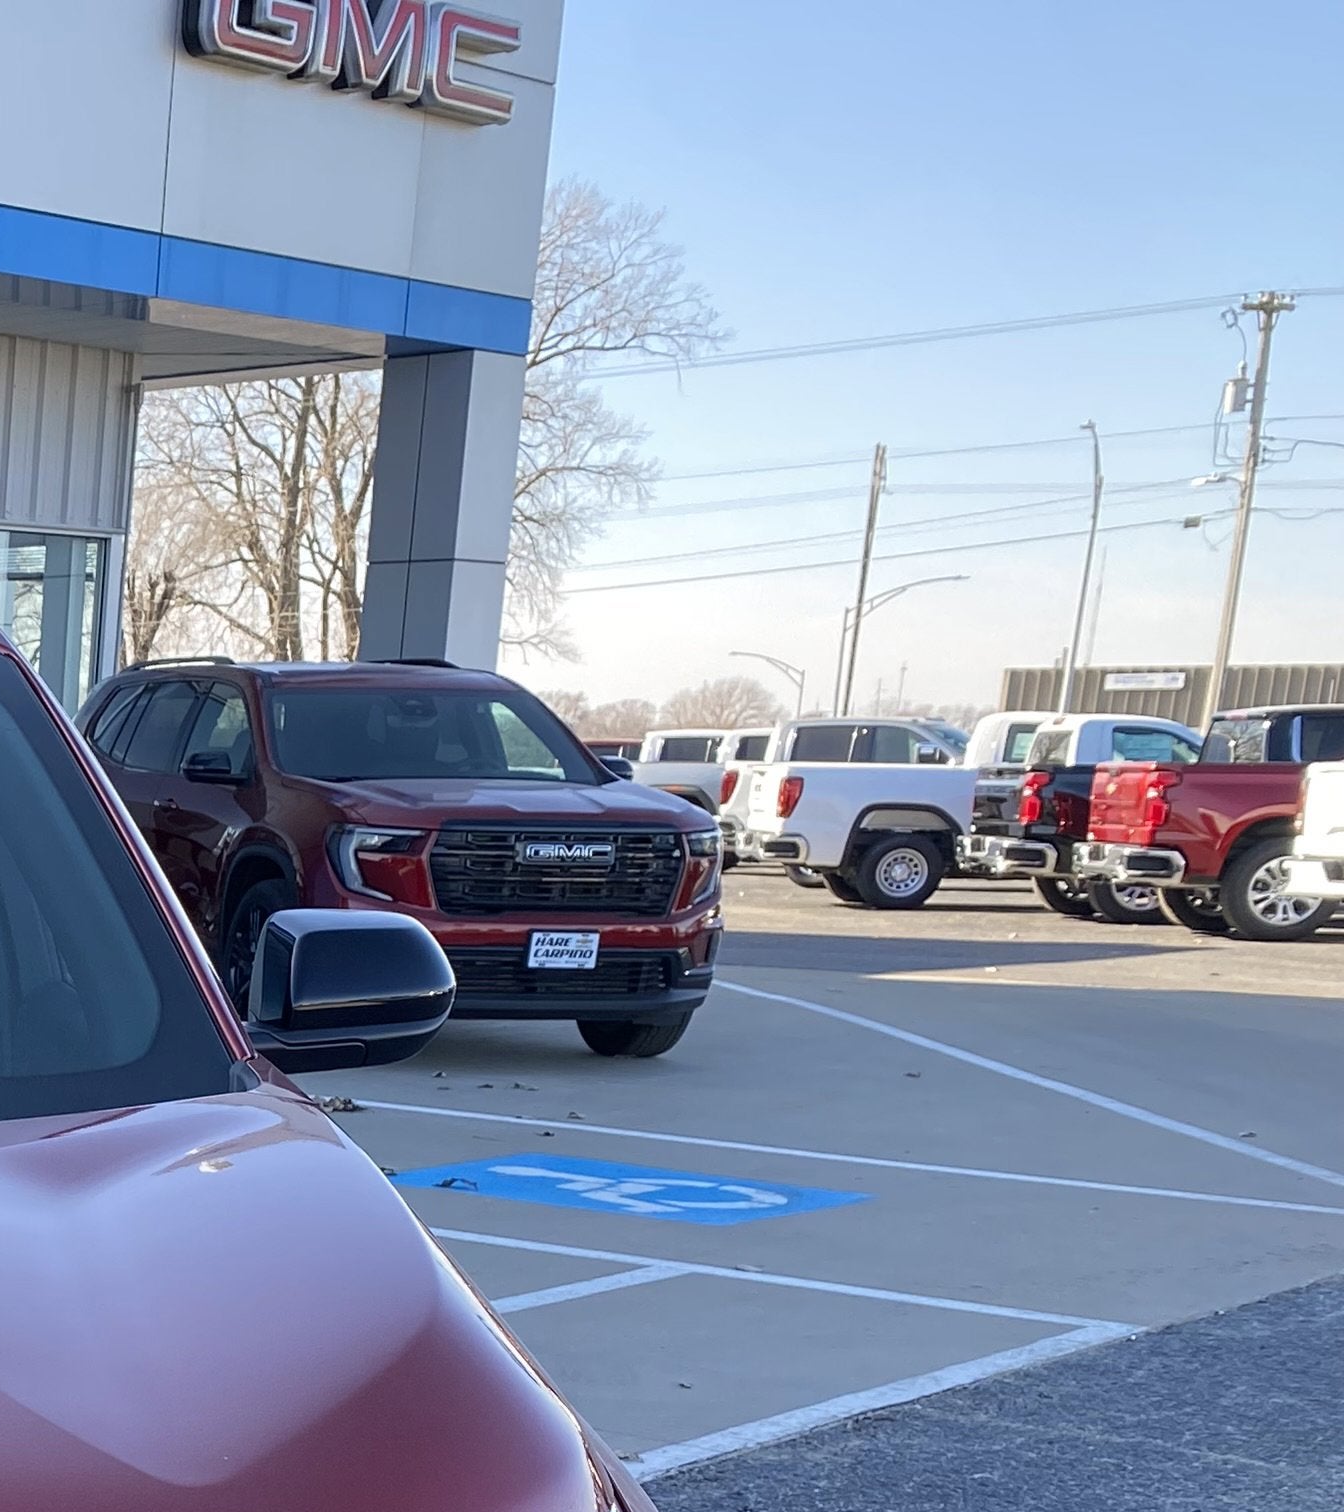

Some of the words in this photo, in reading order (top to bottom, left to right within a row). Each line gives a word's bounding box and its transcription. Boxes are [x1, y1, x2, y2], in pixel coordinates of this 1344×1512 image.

[185, 0, 522, 126] GMC
[526, 844, 612, 861] GMC
[534, 937, 573, 947] HARE
[533, 948, 594, 959] CARPINO
